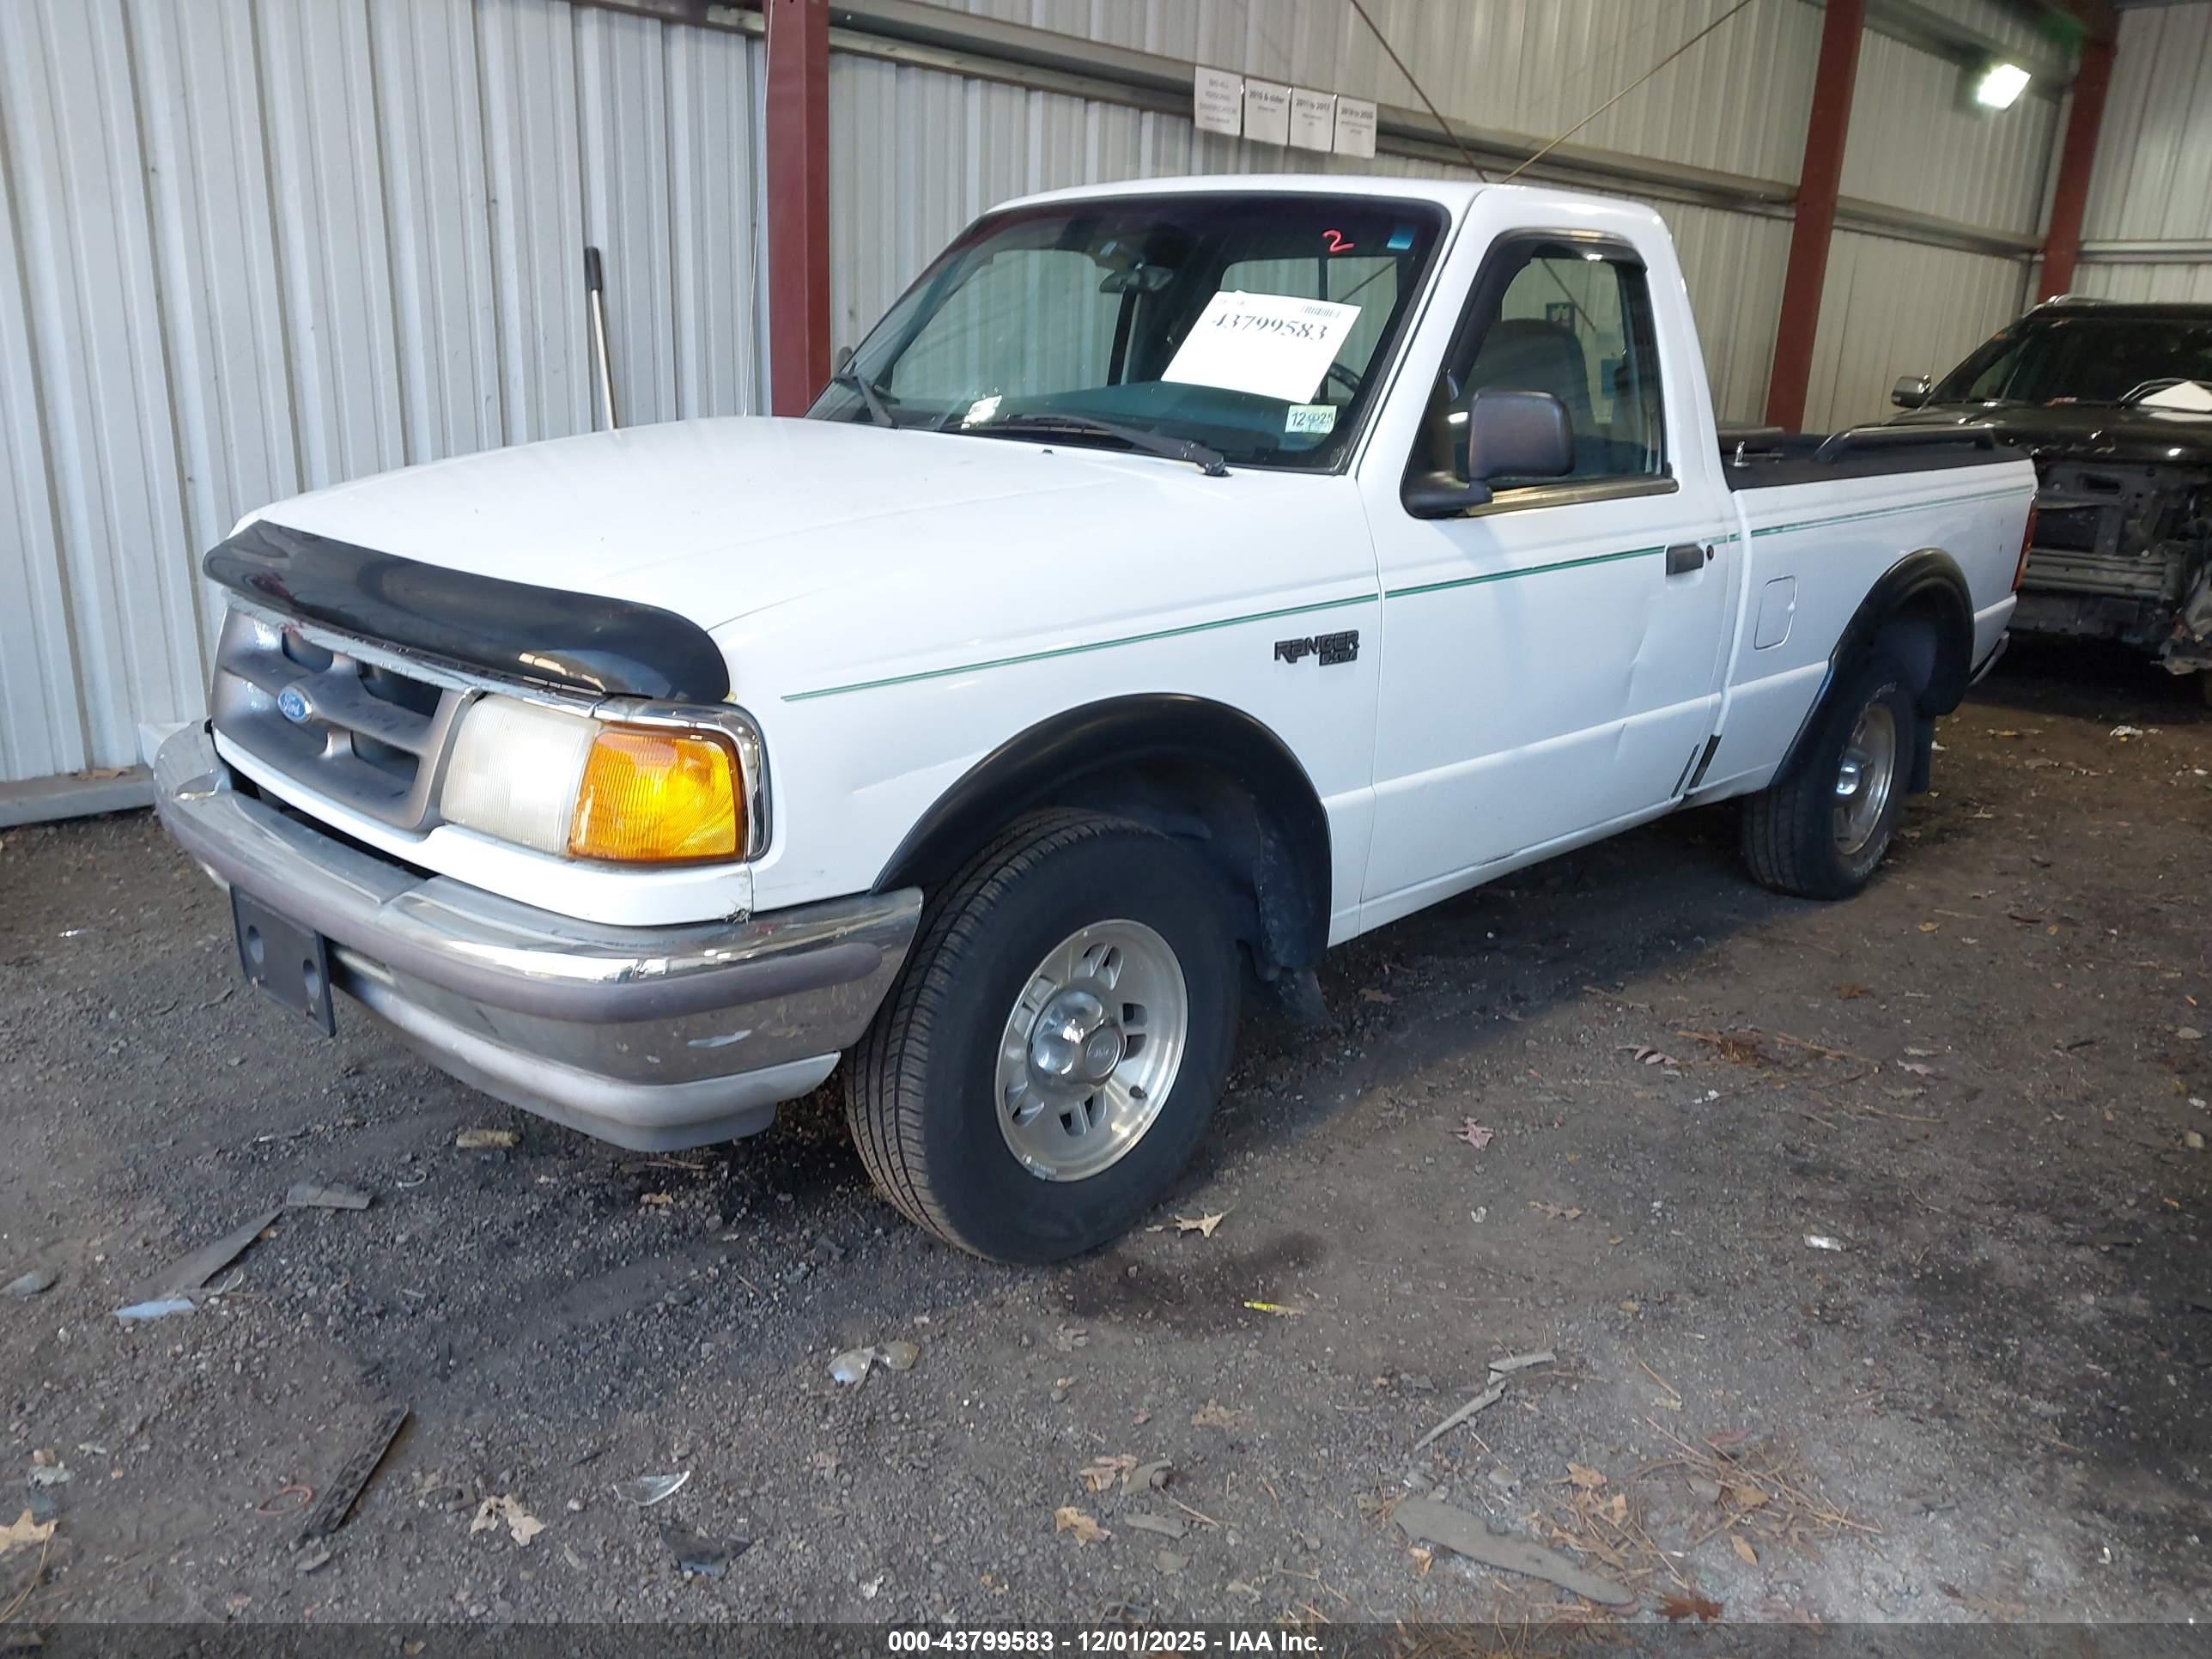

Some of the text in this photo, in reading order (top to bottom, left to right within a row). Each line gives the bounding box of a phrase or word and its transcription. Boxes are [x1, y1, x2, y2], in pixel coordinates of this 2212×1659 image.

[1322, 229, 1354, 252] 2
[1212, 313, 1328, 340] 43799583
[1291, 411, 1305, 427] 12
[1274, 630, 1359, 664] RANGER
